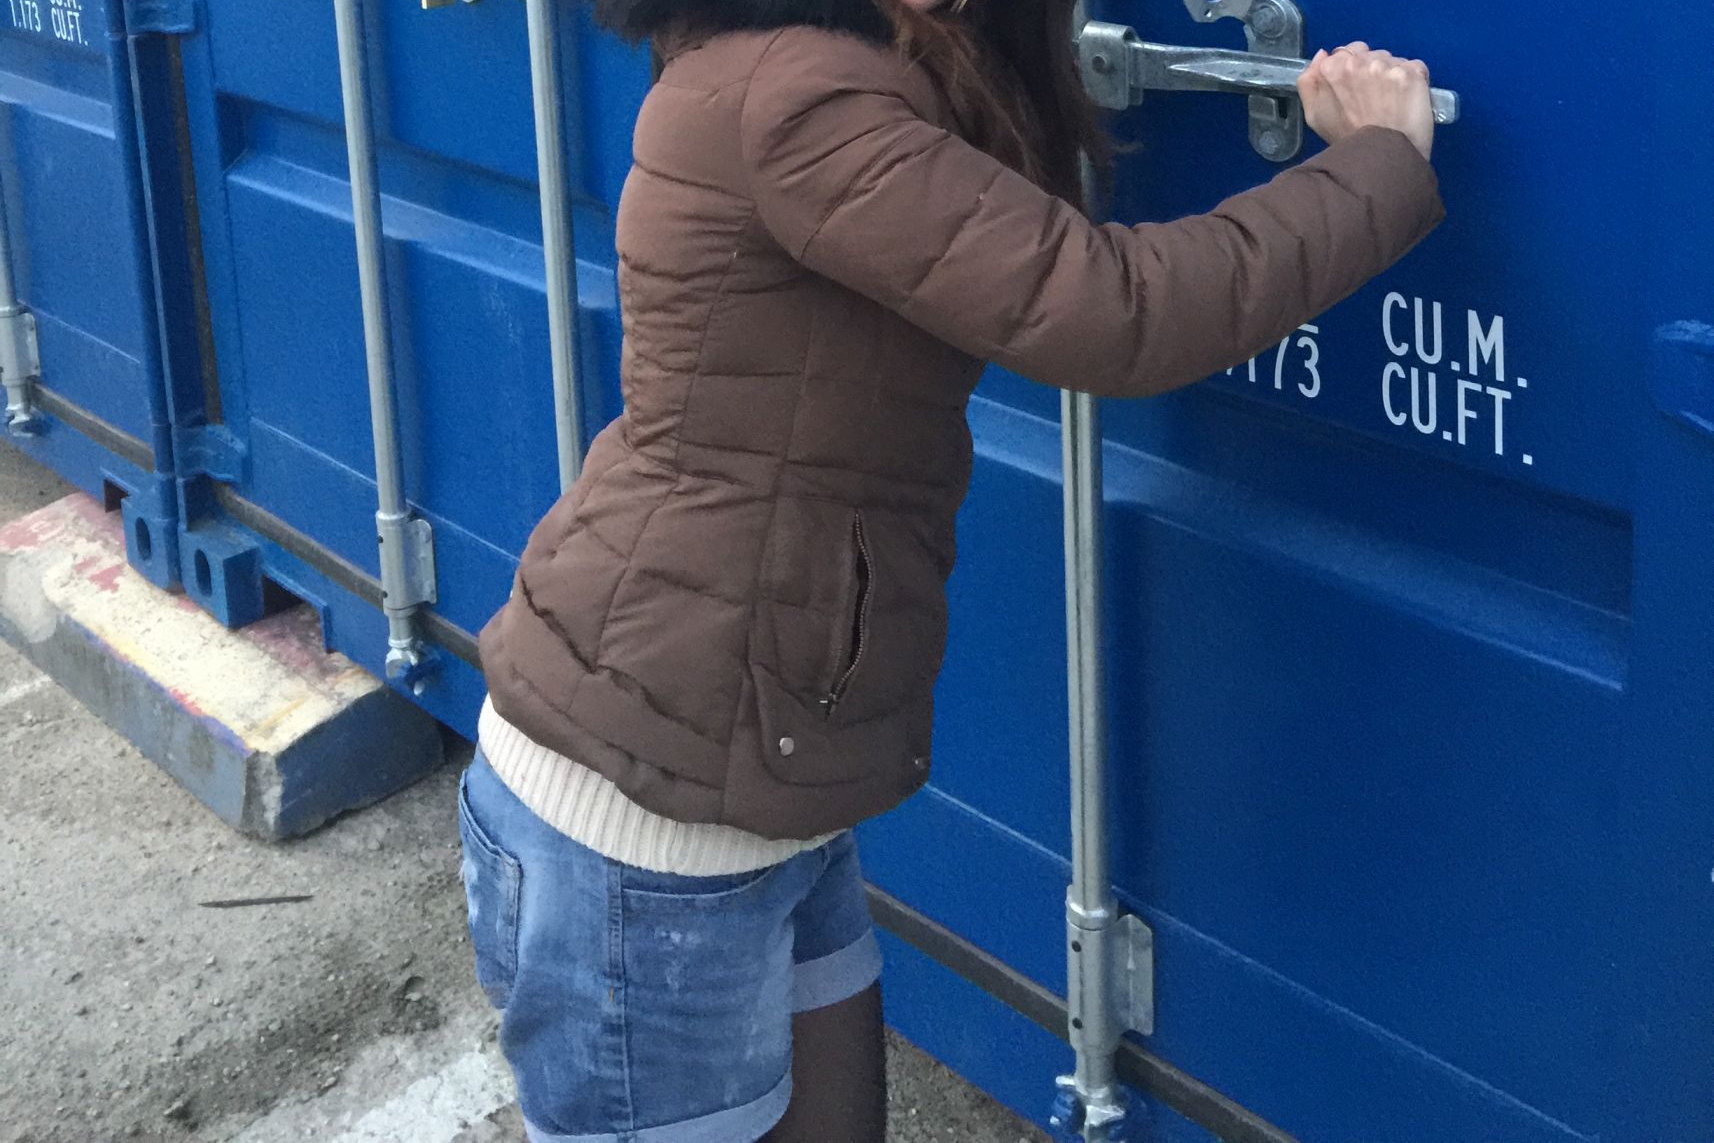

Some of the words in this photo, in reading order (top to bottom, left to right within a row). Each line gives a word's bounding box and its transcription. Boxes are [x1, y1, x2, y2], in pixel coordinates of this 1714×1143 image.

[51, 7, 88, 46] CU.FT.
[1382, 291, 1528, 388] CU.M.
[1382, 361, 1533, 465] CU.FT.
